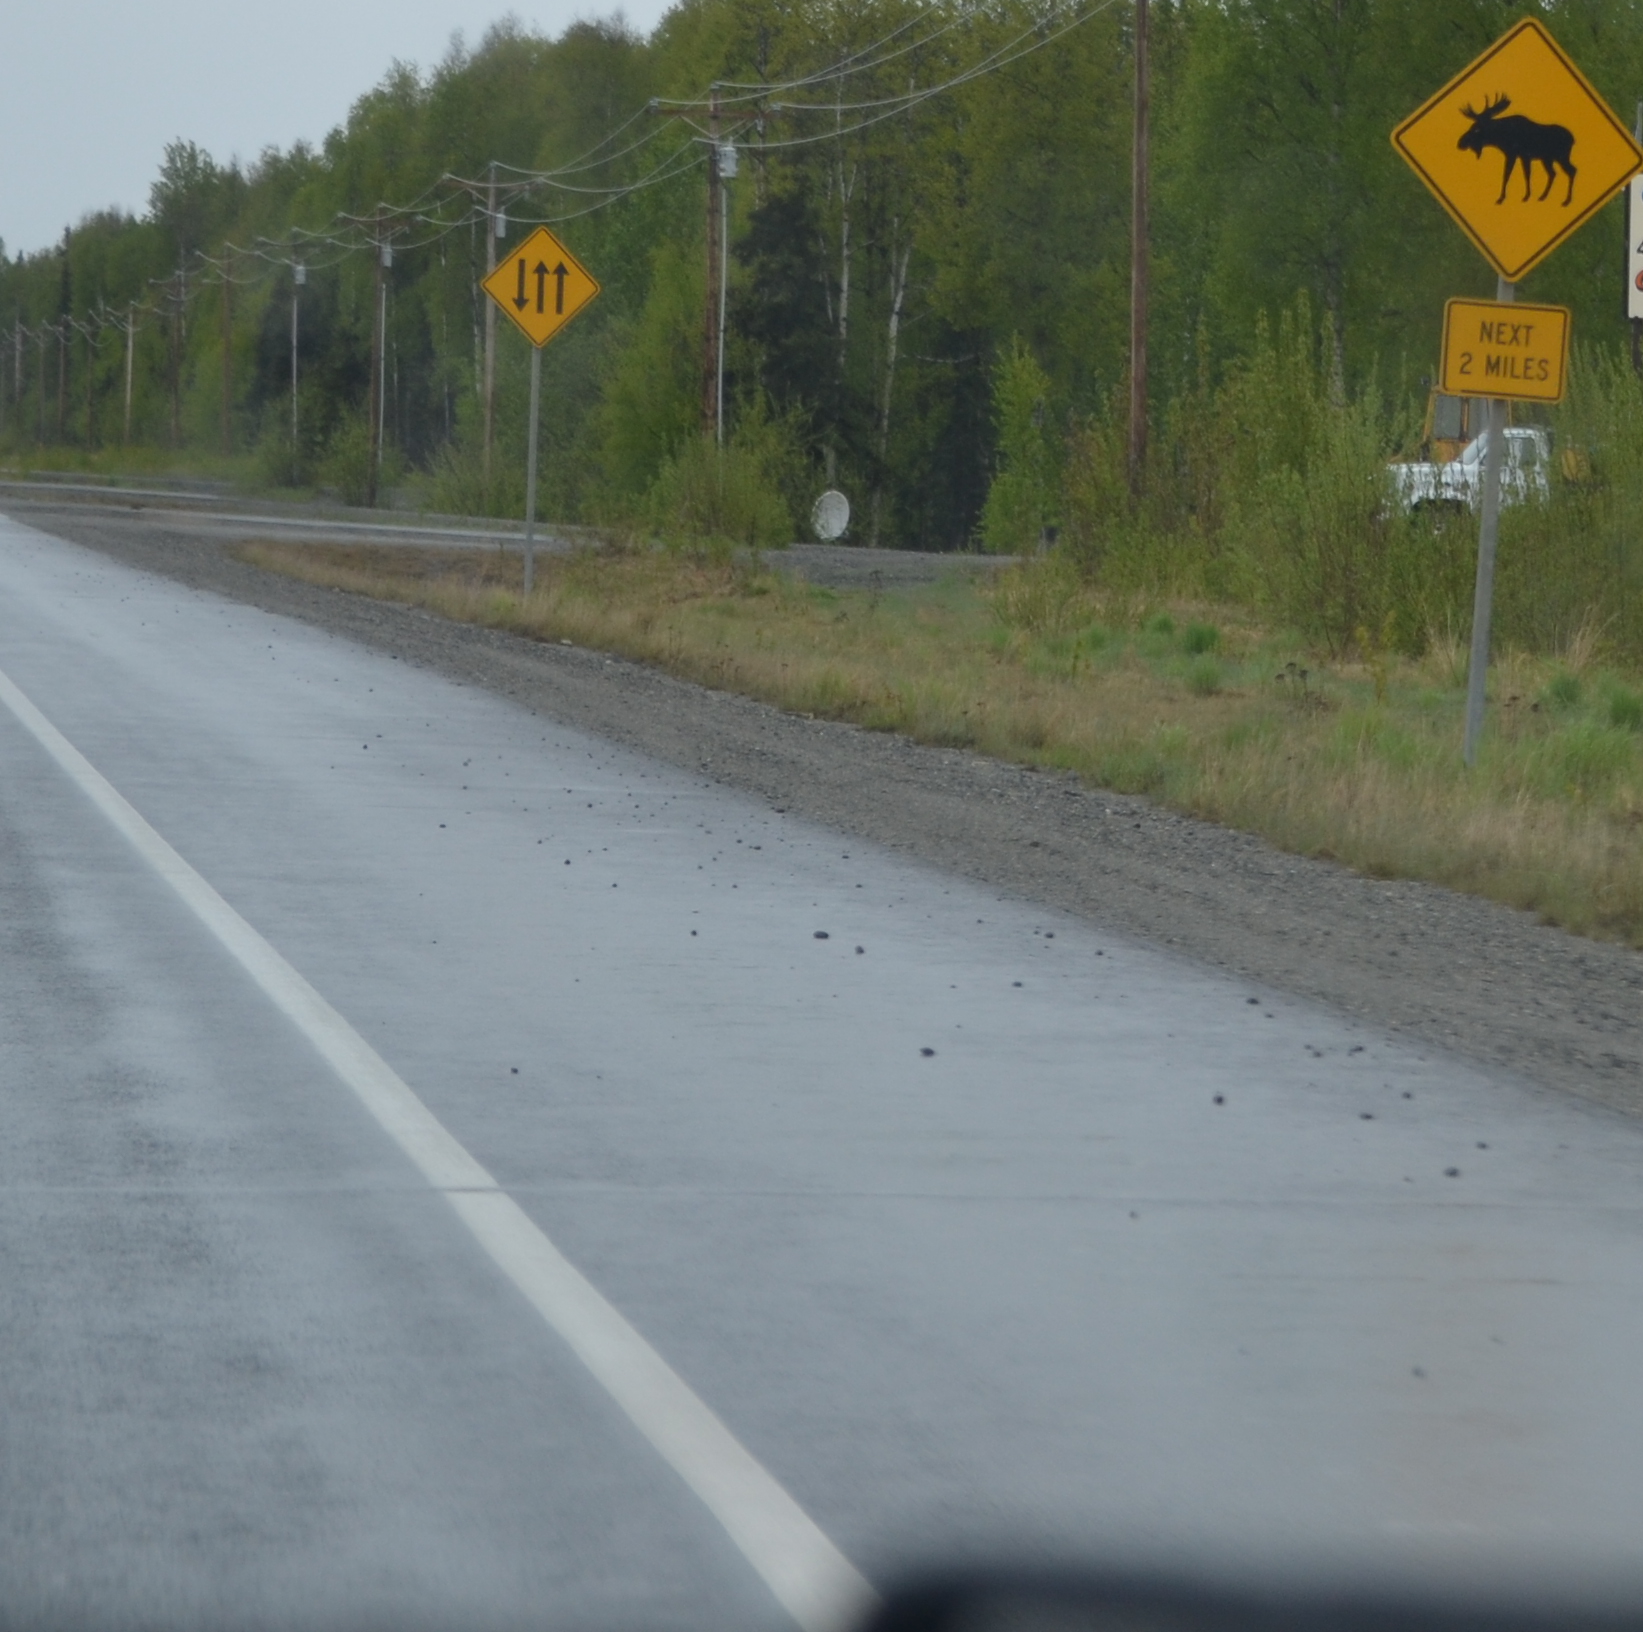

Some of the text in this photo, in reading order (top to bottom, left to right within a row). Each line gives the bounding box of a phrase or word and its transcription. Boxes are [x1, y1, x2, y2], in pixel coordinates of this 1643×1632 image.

[1479, 321, 1534, 347] NEXT
[1459, 352, 1549, 381] 2 MILES
